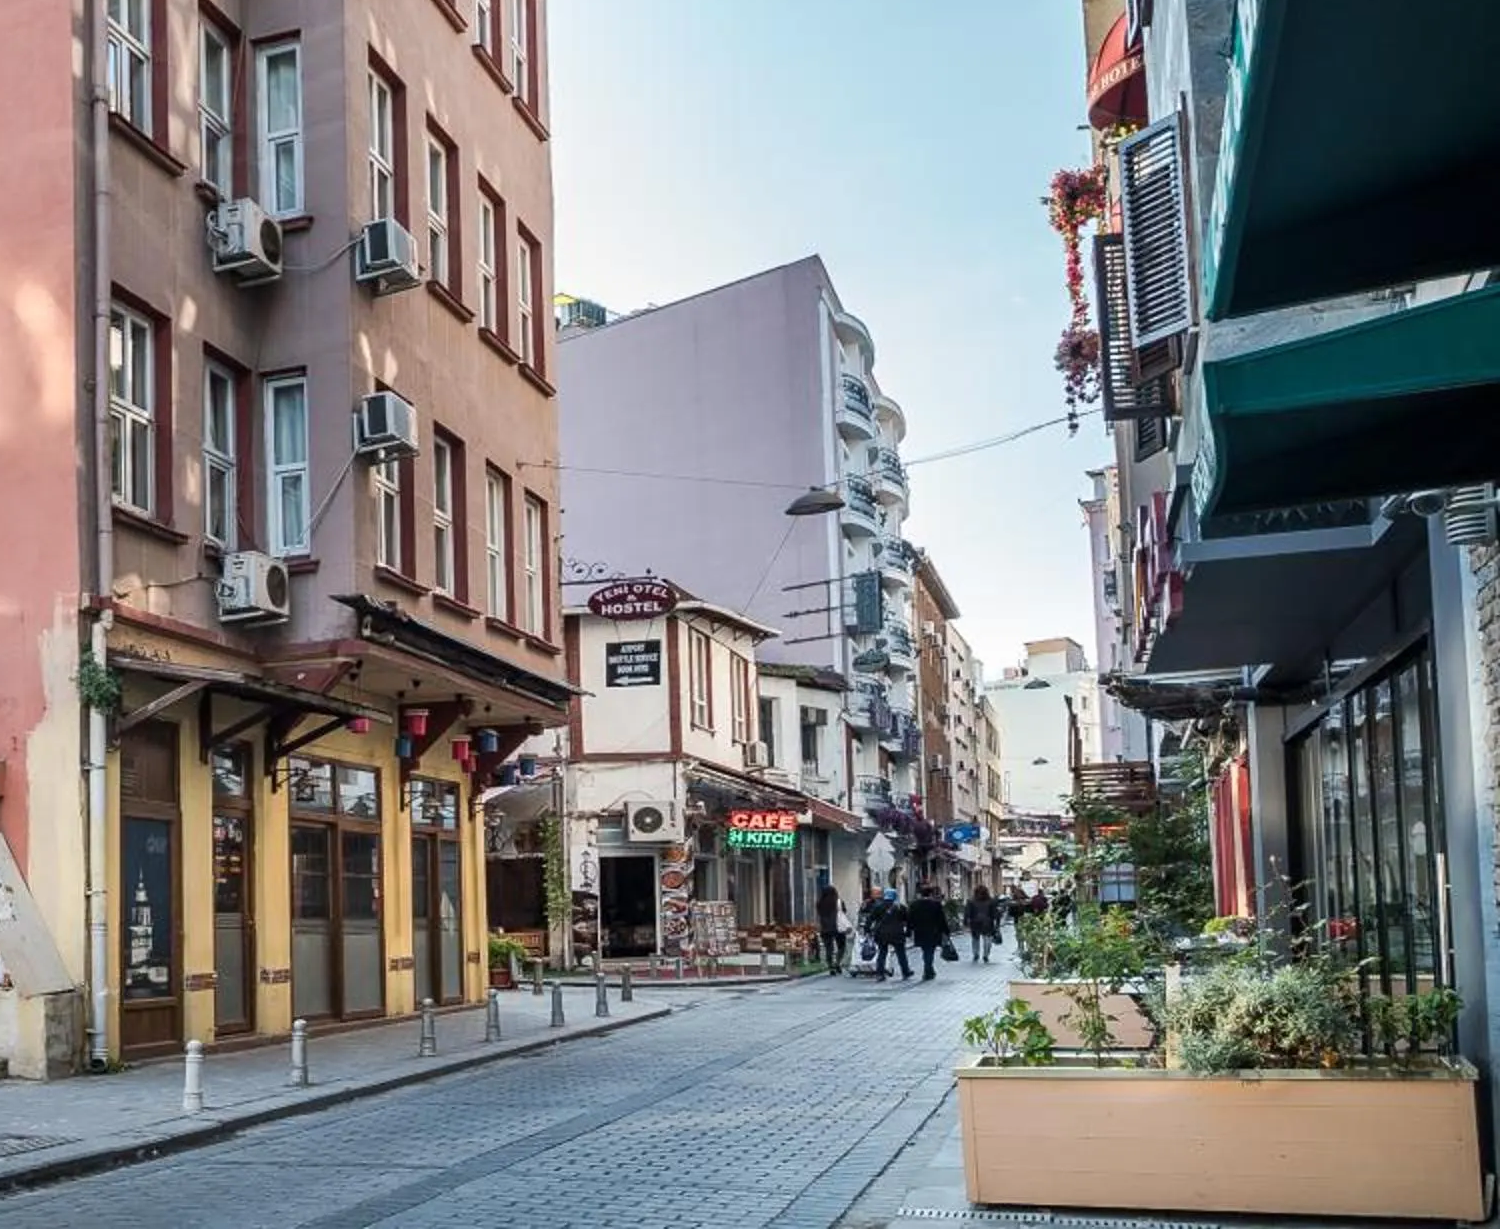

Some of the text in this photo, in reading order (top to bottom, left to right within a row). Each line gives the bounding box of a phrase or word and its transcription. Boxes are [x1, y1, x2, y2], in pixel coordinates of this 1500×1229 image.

[1100, 55, 1142, 89] HOTE
[633, 584, 669, 598] OTEL
[601, 601, 662, 616] HOSTEL
[732, 814, 795, 830] CAFE
